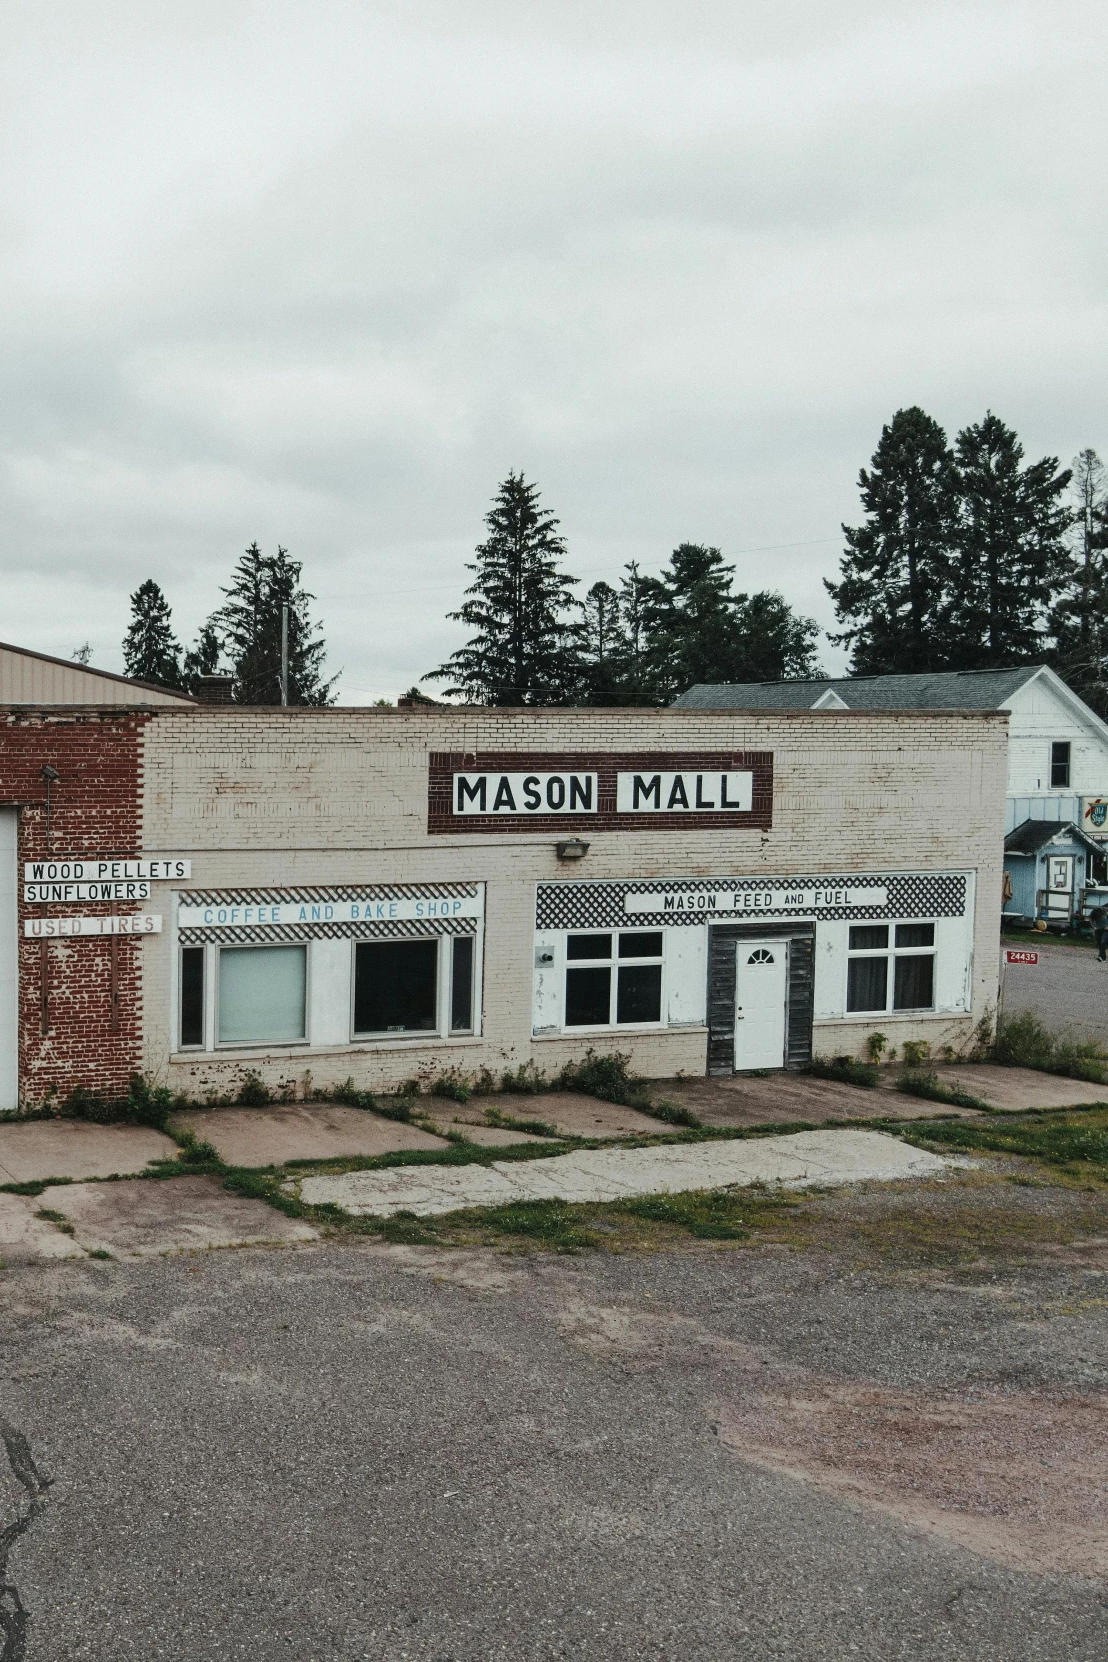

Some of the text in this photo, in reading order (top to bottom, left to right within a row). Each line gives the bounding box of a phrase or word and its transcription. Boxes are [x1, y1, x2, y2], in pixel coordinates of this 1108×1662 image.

[457, 774, 740, 812] MASON MALL
[32, 861, 185, 880] WOOD PELLETS
[27, 883, 148, 901] SUNFLOWERS
[664, 891, 852, 910] MASON FEED AND FUEL
[204, 901, 462, 924] COFFEE AND BAKE SHOP
[32, 917, 154, 936] USED TIRES
[1010, 952, 1036, 961] 24435
